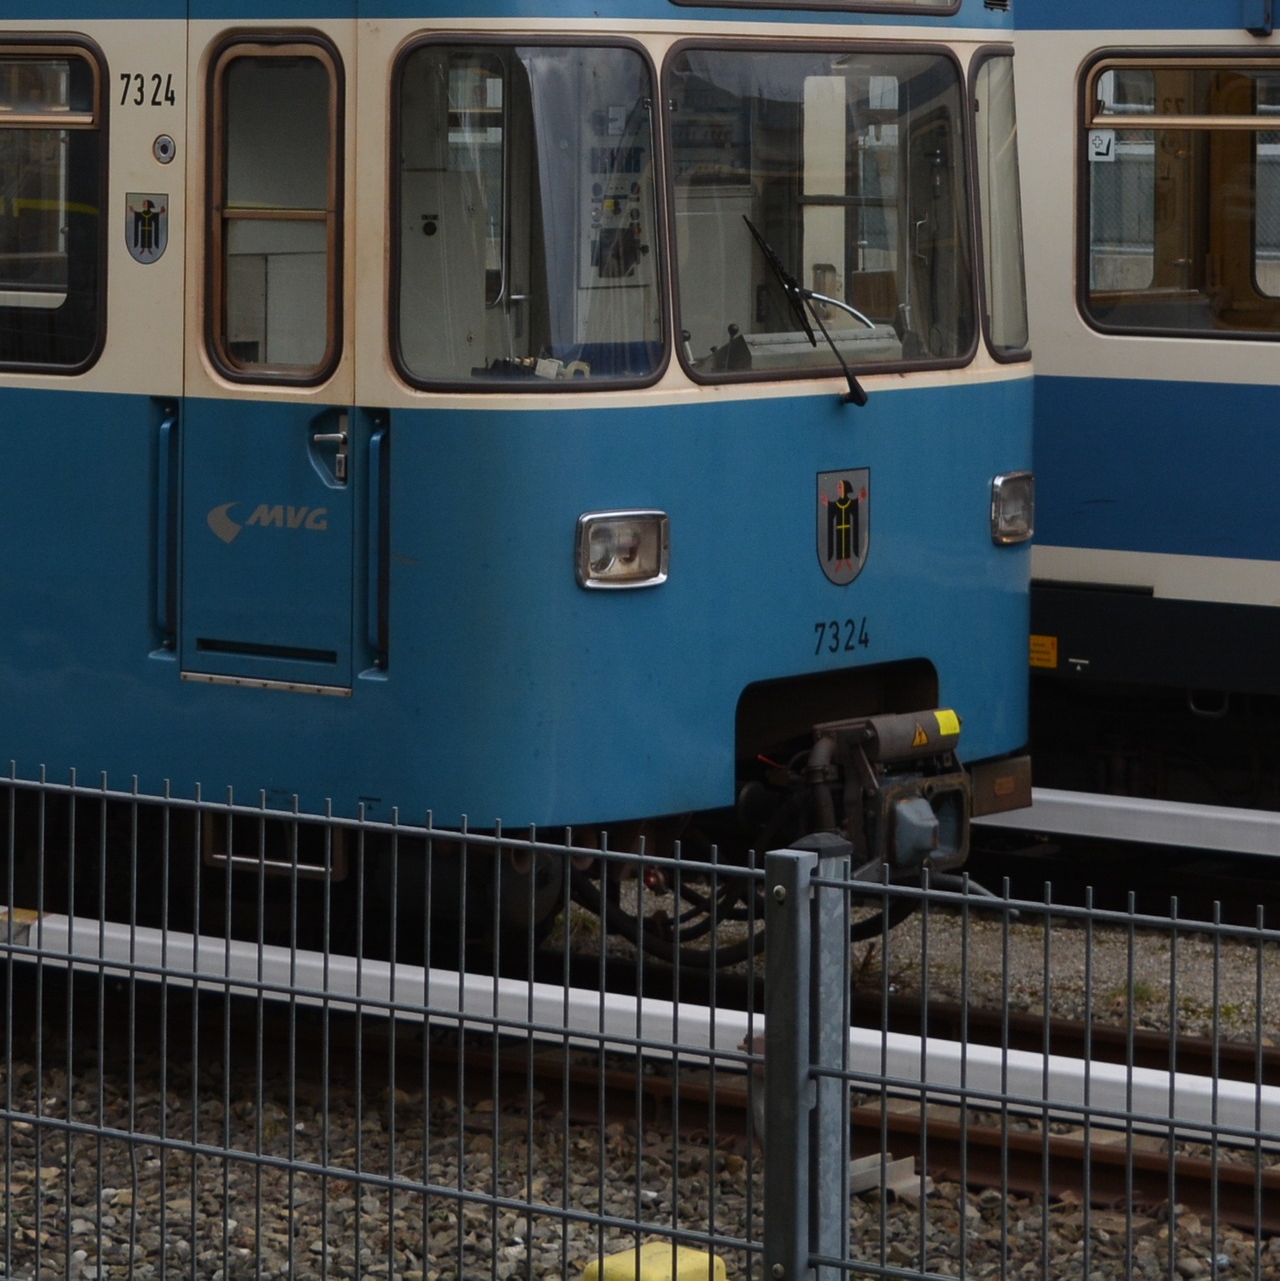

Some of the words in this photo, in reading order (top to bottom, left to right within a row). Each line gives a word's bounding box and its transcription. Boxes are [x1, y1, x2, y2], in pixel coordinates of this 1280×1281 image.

[120, 74, 175, 106] 7324
[247, 504, 327, 530] MVG
[814, 616, 870, 656] 7324
